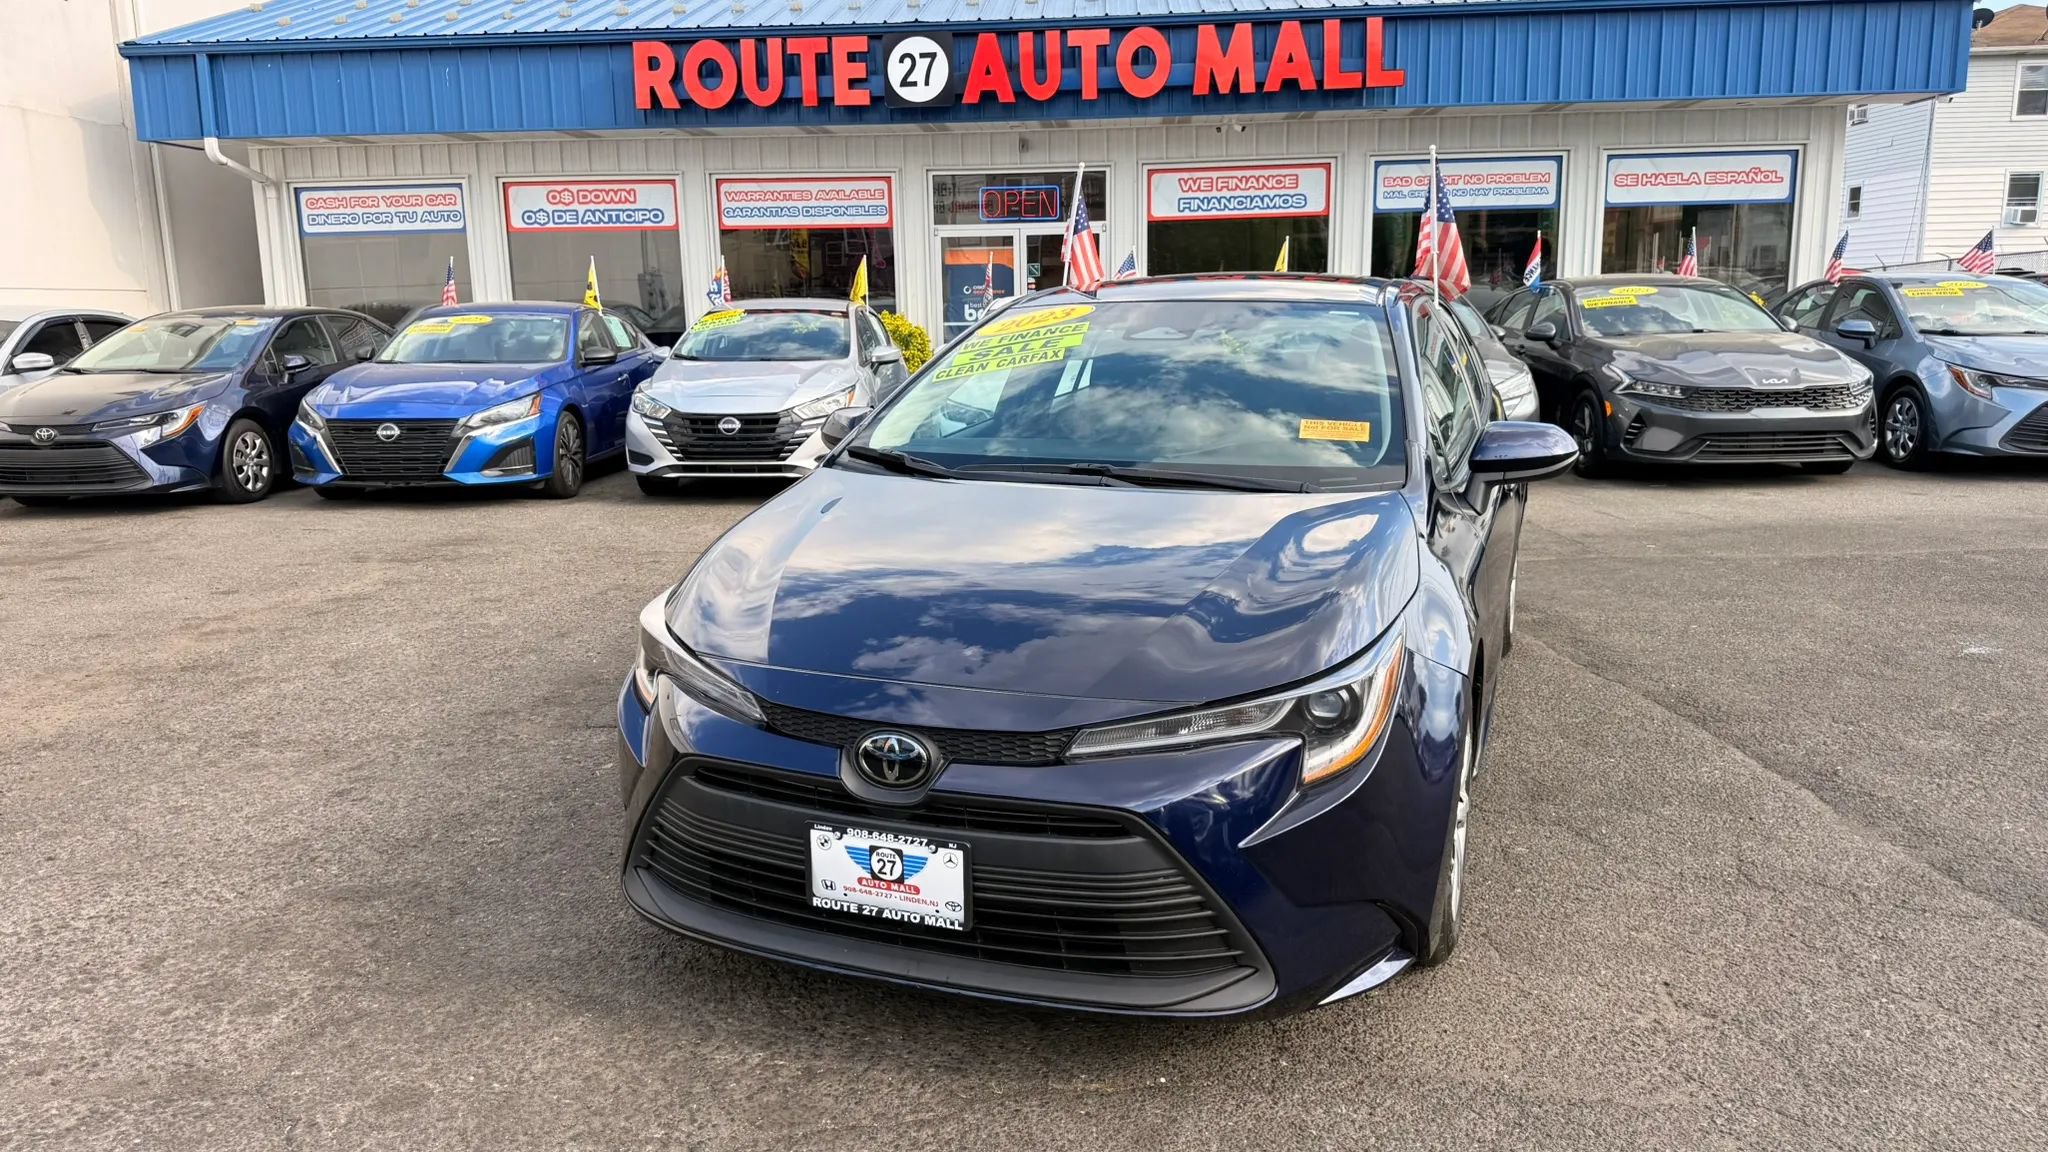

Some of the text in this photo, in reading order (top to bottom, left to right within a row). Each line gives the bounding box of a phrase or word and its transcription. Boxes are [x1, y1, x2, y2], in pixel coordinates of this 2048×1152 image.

[632, 17, 1405, 110] ROUTE 27 AUTO MALL
[1178, 174, 1299, 192] WE FINANCE
[1383, 176, 1412, 188] BAD
[1463, 174, 1485, 185] NO
[1486, 172, 1552, 185] PROBLEM
[1614, 167, 1784, 187] SE HABLA ESPAÑOL
[577, 188, 636, 204] DOWN
[725, 189, 884, 202] WARRANTIES AVAILABLE
[1383, 190, 1406, 199] MAL
[1451, 188, 1469, 197] NO
[1469, 187, 1491, 197] HAY
[1493, 186, 1549, 197] PROBLEMA
[306, 193, 457, 210] CASH FOR YOUR CAR
[982, 190, 1057, 218] OPEN
[1178, 194, 1307, 212] FINANCIAMOS
[307, 210, 462, 226] DINERO POR TU AUTO
[552, 210, 579, 225] DE
[581, 208, 664, 225] ANTICIPO
[723, 205, 888, 218] GARANTIAS DISPONIBLES
[962, 323, 1088, 350] WE FINANCE
[969, 337, 1064, 361] SALE
[935, 350, 1061, 380] CLEAN CARFAX
[814, 823, 833, 831] Linden
[847, 827, 928, 848] 908-648-2727
[875, 851, 896, 860] ROUTE
[876, 858, 897, 877] 27
[843, 885, 893, 899] 908-648-2727
[861, 877, 917, 894] AUTO MALL
[812, 896, 963, 931] ROUTE 27 AUTO MALL
